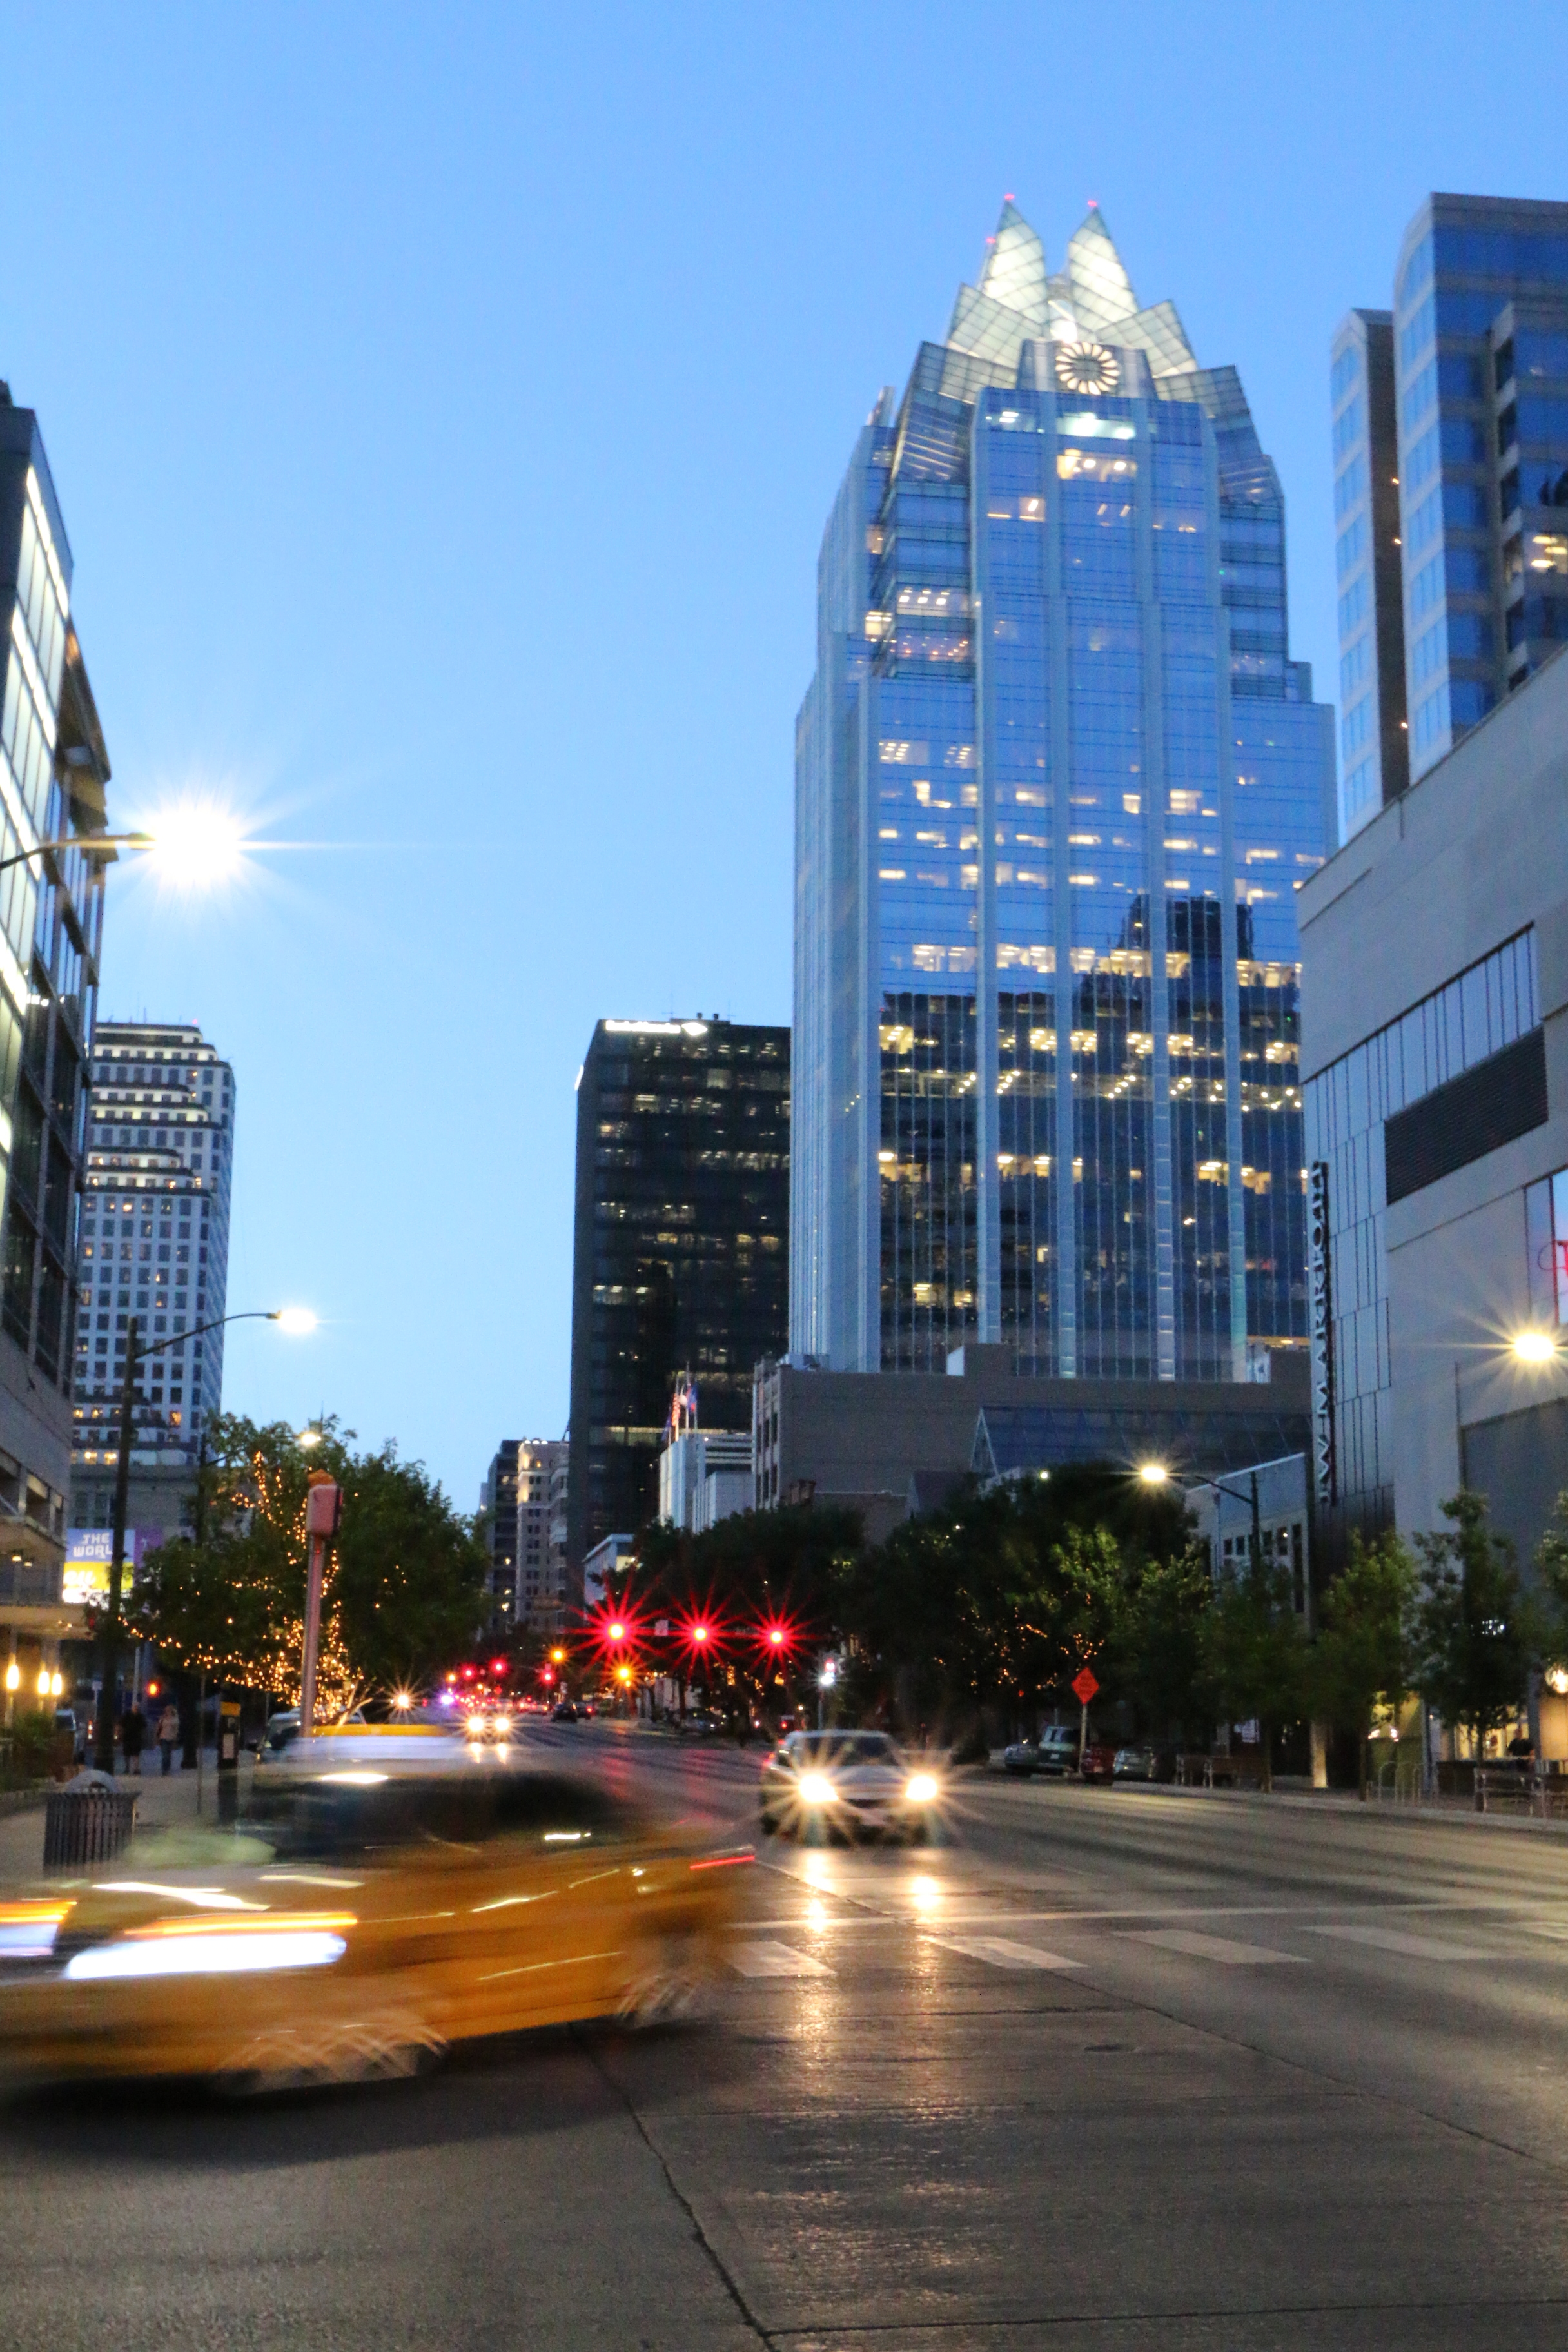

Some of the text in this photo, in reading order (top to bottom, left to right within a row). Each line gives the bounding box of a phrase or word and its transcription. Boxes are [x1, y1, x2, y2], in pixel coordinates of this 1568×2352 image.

[1311, 1161, 1328, 1415] MARRIOTT
[83, 1533, 110, 1545] THE
[73, 1545, 113, 1559] WORL
